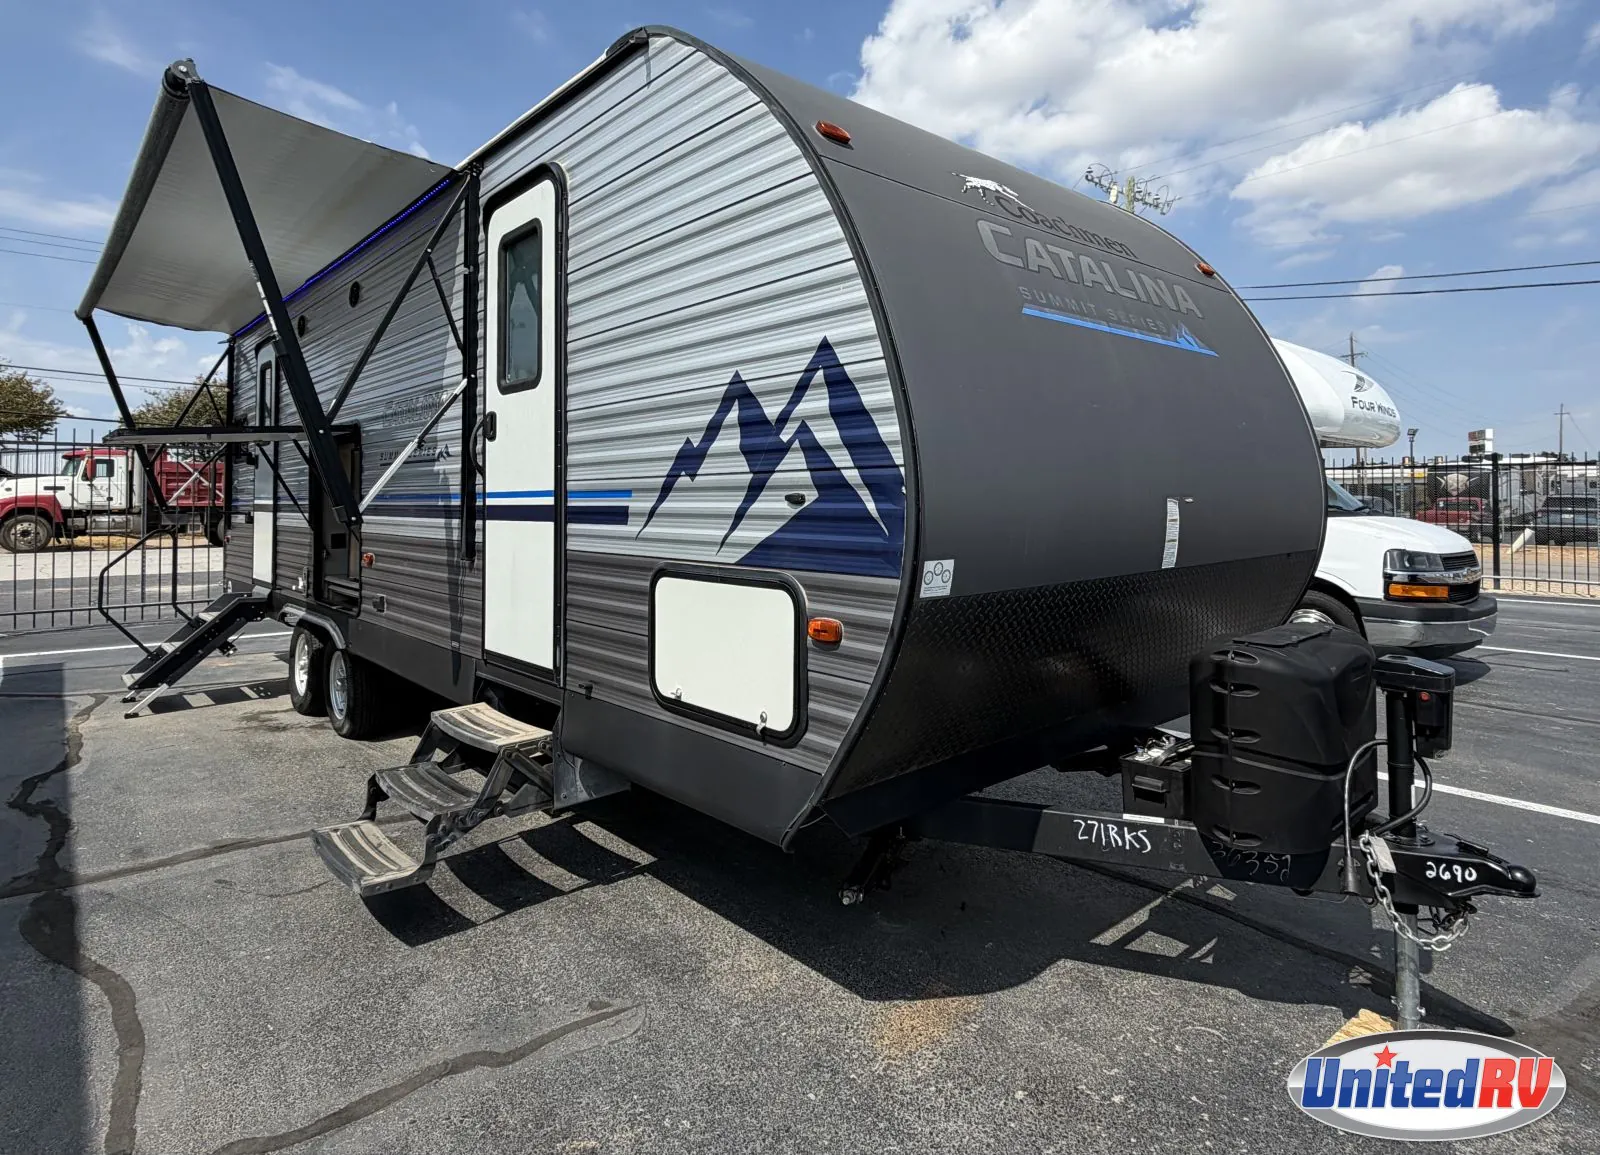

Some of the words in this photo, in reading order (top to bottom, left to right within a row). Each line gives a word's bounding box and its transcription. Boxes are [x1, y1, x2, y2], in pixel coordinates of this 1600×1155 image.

[995, 196, 1140, 259] Coachmen
[976, 218, 1204, 319] CATALINA
[1018, 286, 1097, 315] SUMMIT
[1106, 308, 1169, 333] SERIES
[1351, 396, 1376, 412] FOUR
[1375, 401, 1397, 418] WINDS
[1073, 819, 1152, 853] 271RKS
[1425, 861, 1478, 883] 2690
